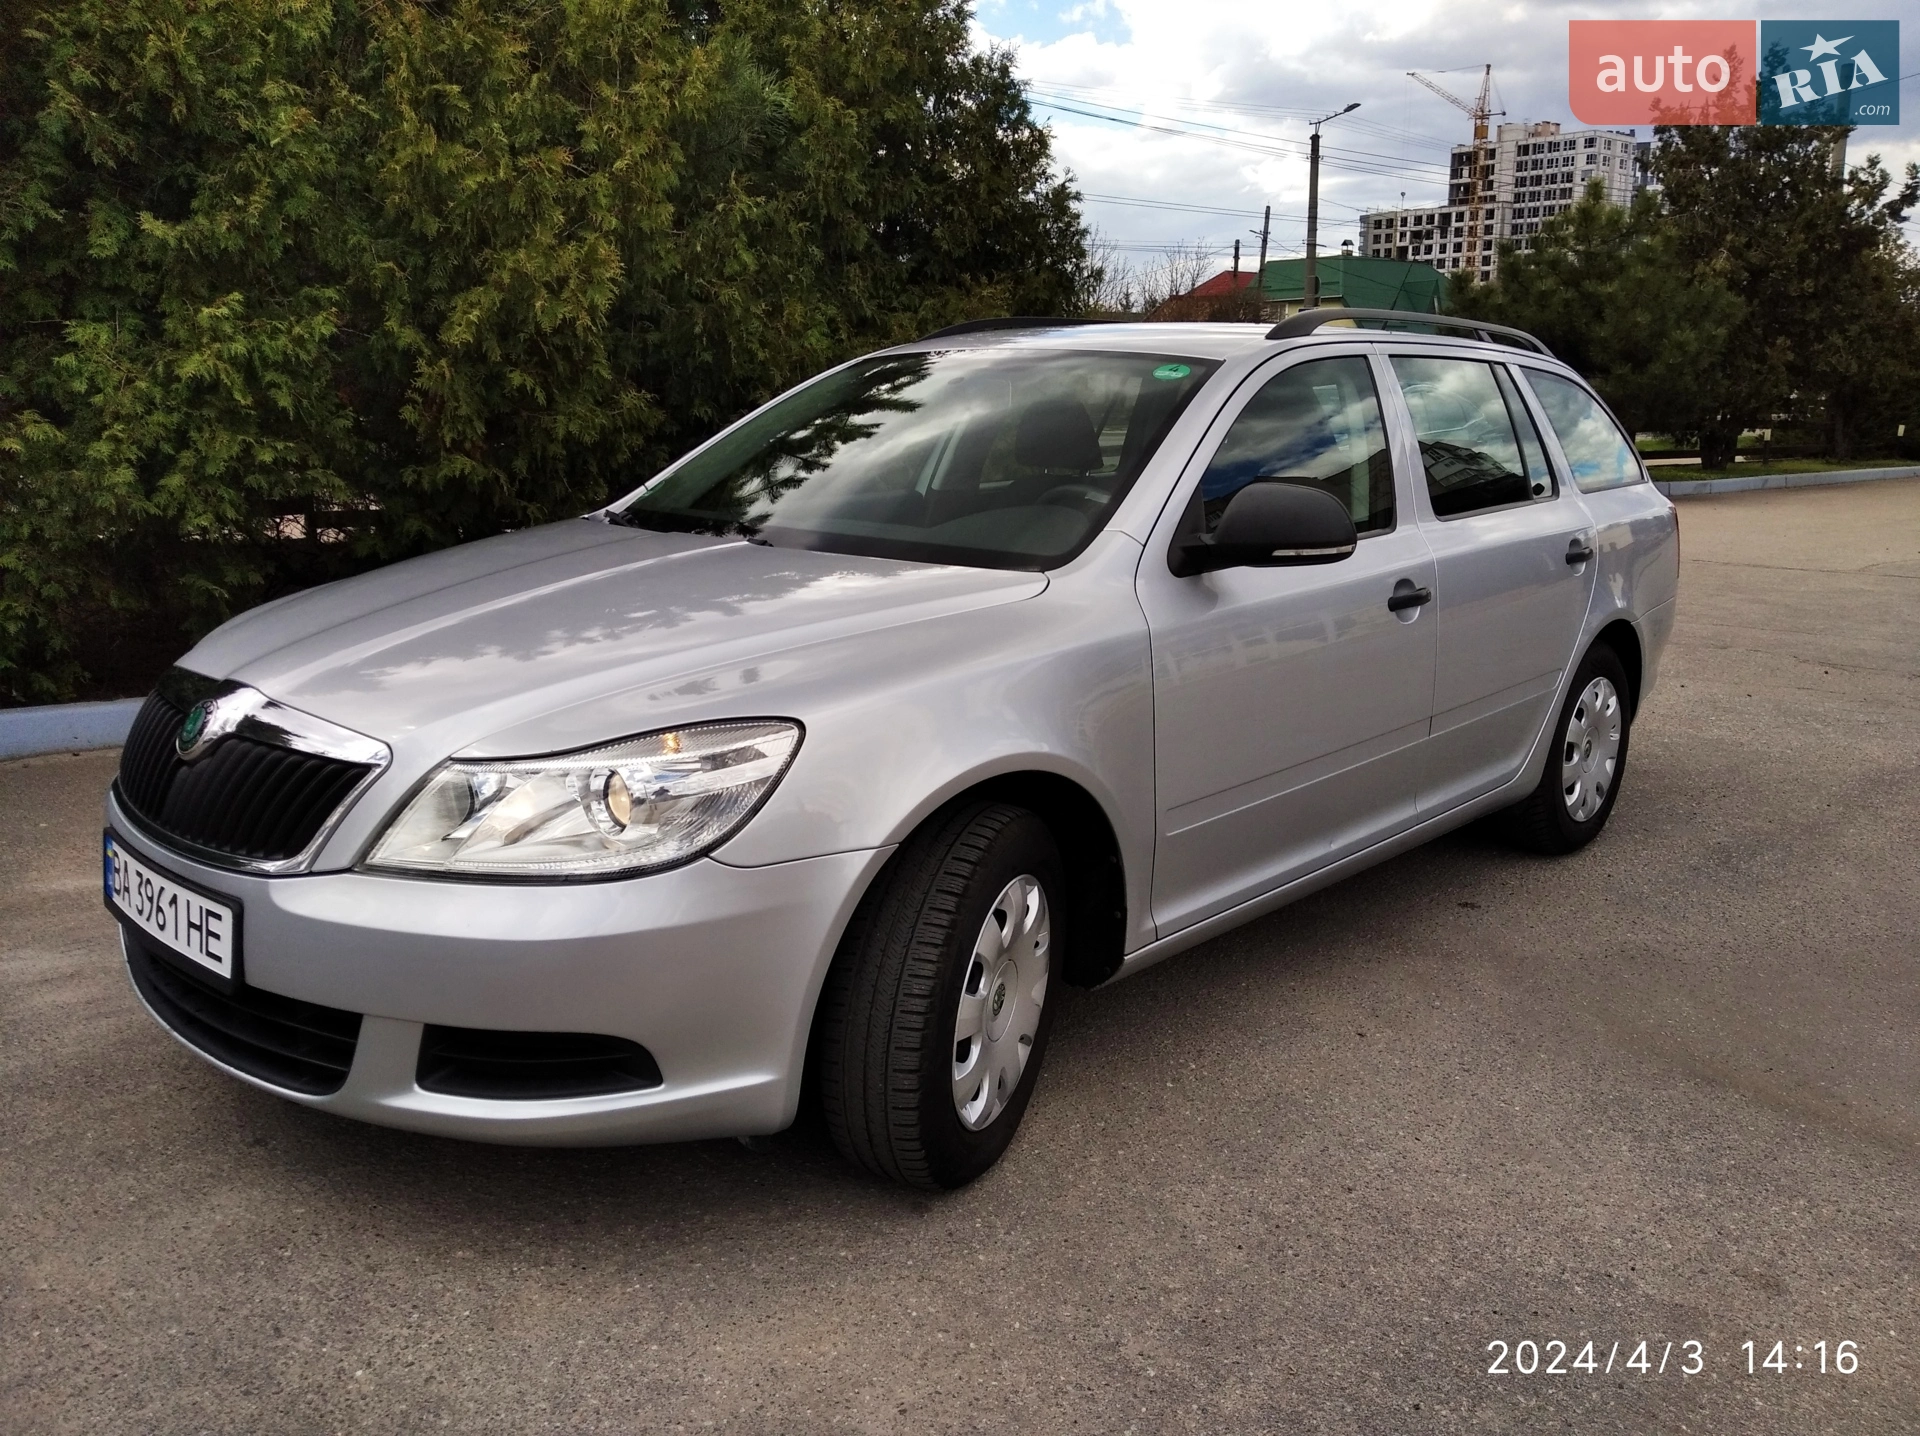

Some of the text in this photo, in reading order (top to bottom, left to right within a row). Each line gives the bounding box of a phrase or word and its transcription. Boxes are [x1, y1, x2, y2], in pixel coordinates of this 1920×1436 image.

[113, 849, 223, 964] BA 3961 HE
